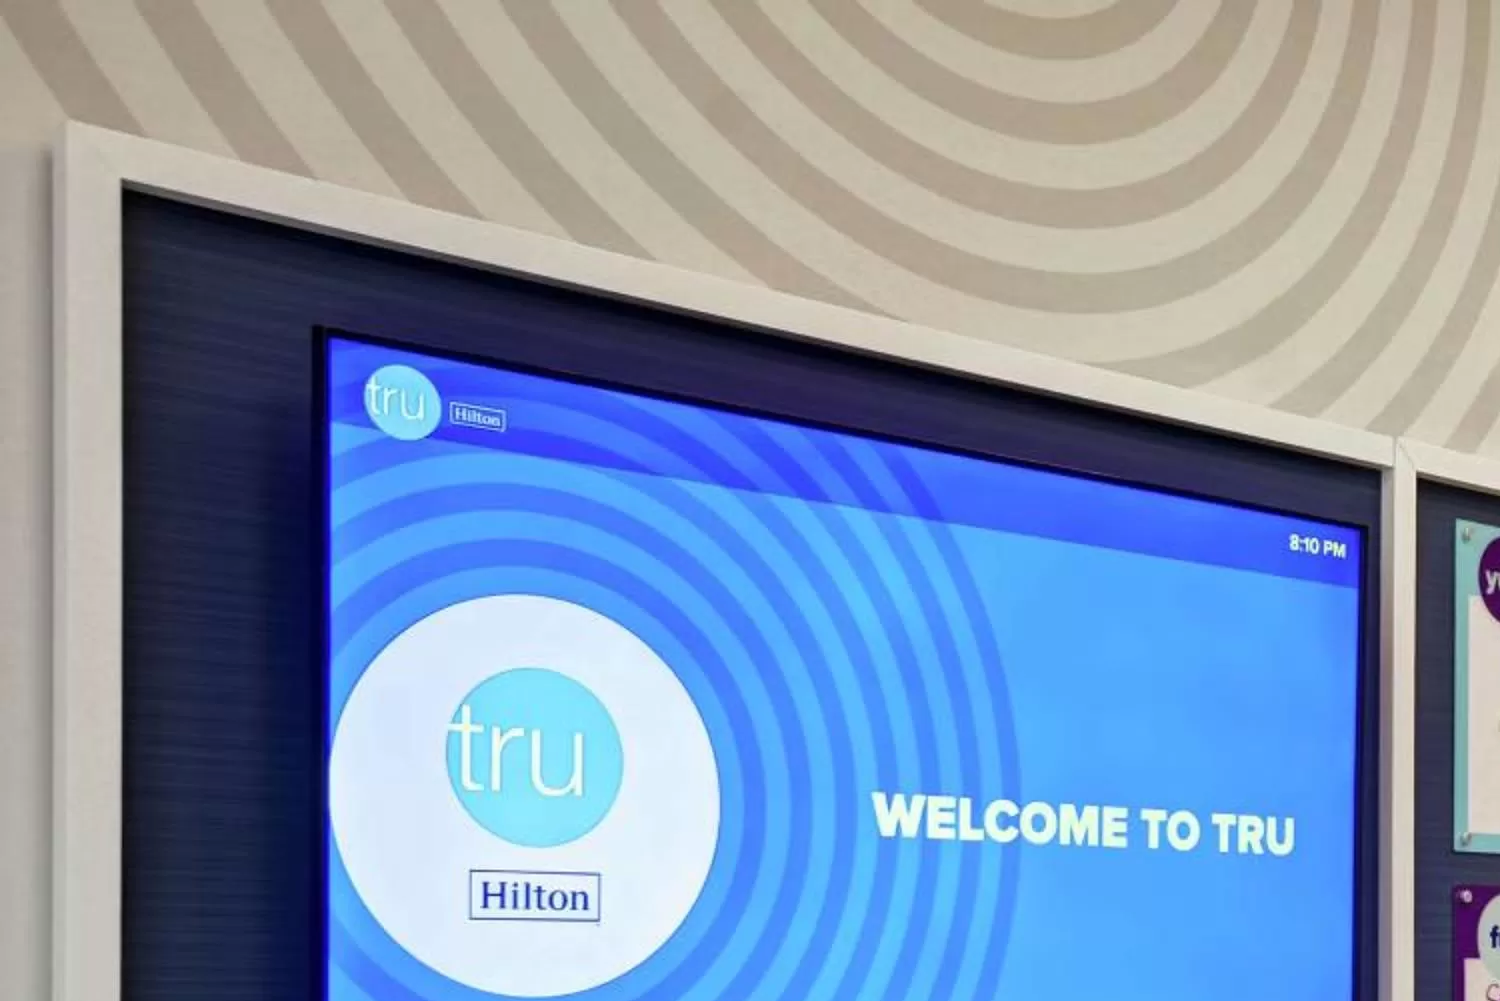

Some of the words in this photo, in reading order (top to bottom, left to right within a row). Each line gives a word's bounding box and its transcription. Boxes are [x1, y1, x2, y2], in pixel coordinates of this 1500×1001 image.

[366, 376, 424, 421] tru
[455, 407, 501, 426] Hilton
[1289, 533, 1320, 554] 8:10
[1323, 540, 1347, 558] PM
[446, 704, 584, 797] tru
[871, 791, 1128, 848] WELCOME
[1141, 808, 1200, 851] TO
[1212, 813, 1296, 856] TRU
[480, 881, 590, 911] Hilton
